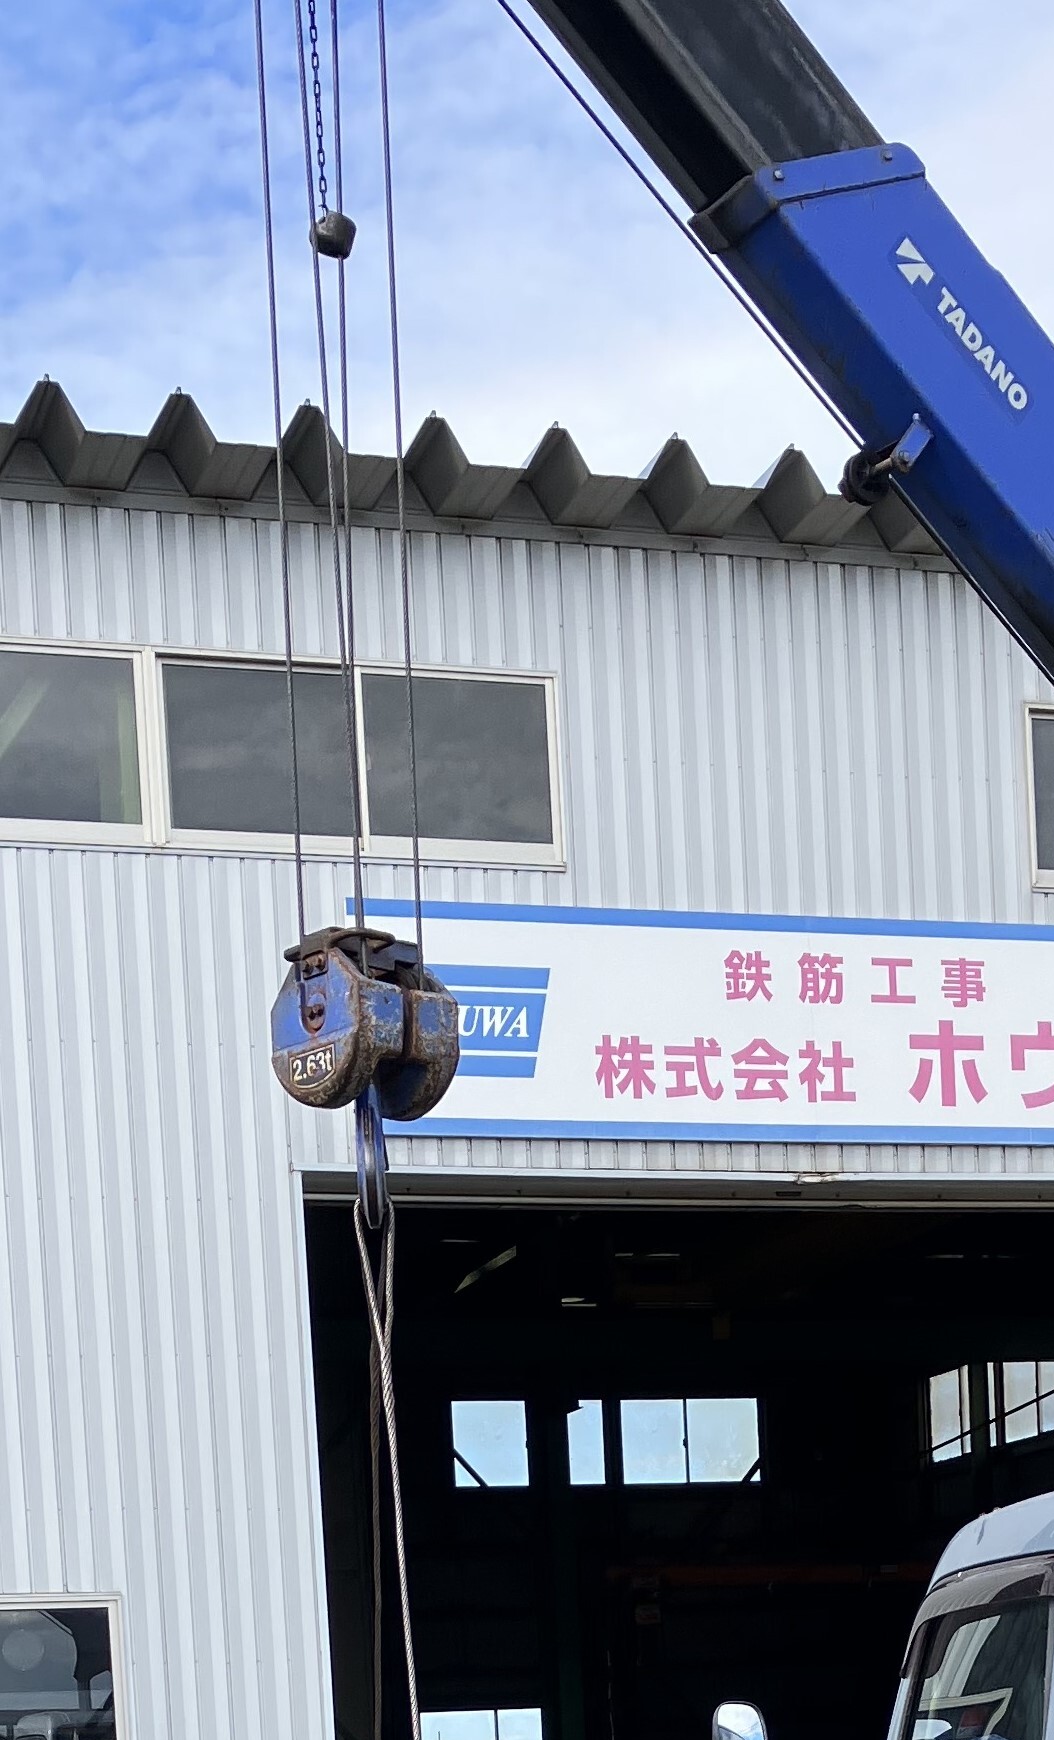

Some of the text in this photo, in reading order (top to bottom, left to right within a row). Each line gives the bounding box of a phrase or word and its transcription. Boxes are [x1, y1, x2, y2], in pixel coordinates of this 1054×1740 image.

[937, 287, 1028, 410] TADANO
[723, 949, 988, 1009] 鉄筋工事
[458, 1004, 530, 1038] UWA
[594, 1034, 858, 1104] 株式会社
